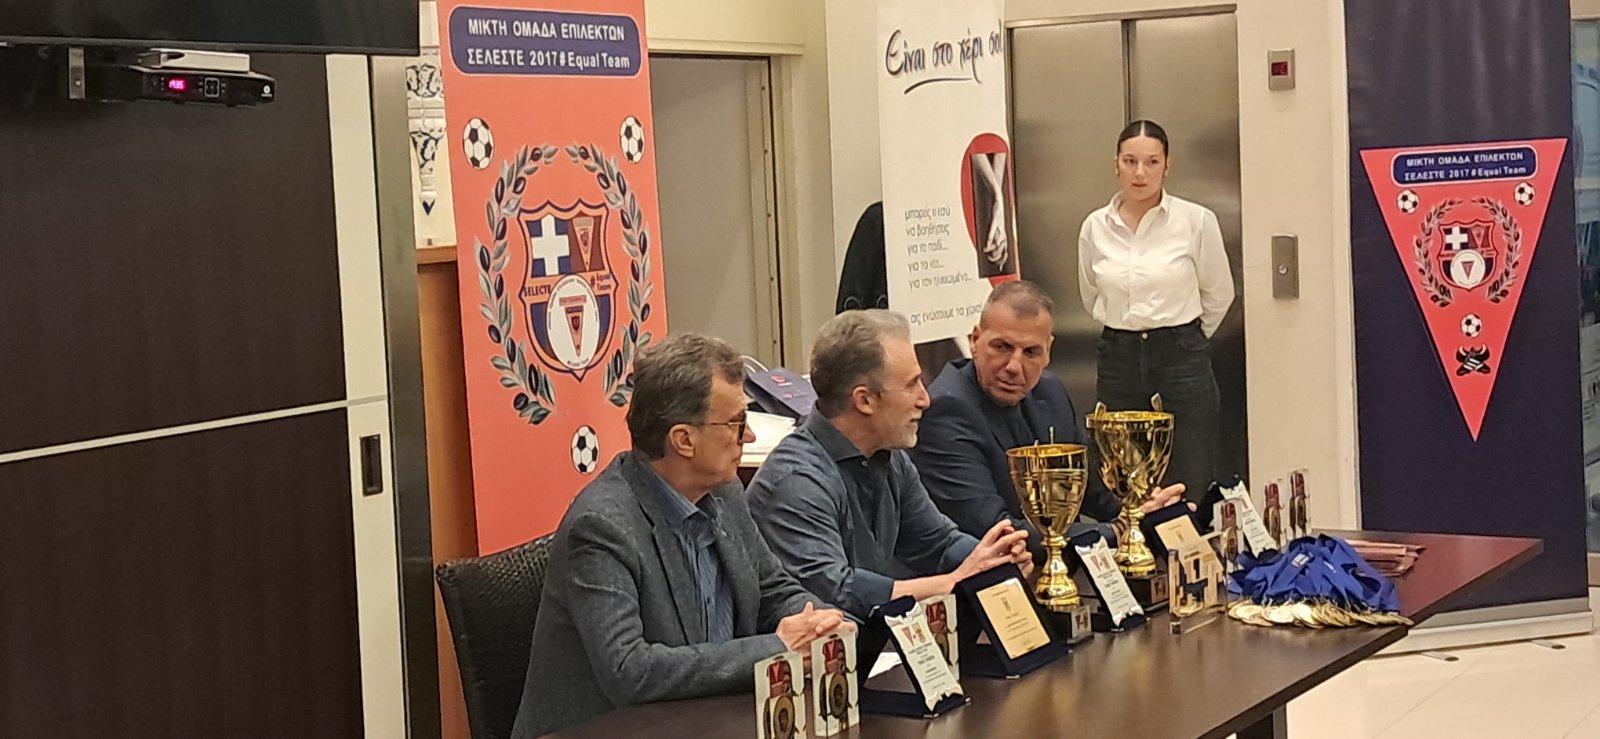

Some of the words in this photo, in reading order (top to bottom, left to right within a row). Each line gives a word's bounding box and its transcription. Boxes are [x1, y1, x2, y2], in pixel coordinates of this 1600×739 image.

[468, 19, 508, 36] ΜΙΚΤΗ
[513, 20, 557, 38] ΟΜΑΔΑ
[561, 23, 625, 41] ΕΠΙΛΕΚΤΩΝ
[467, 48, 525, 66] ΣΕΛΕΣΤΕ
[601, 53, 630, 69] Team
[1406, 157, 1435, 167] ΜΙΚΤΗ
[1438, 155, 1471, 165] ΟΜΑΔΑ
[1474, 152, 1523, 163] ΕΠΙΛΕΚΤΩΝ
[1404, 170, 1445, 181] ΣΕΛΕΣΤΕ
[1503, 166, 1527, 175] Team
